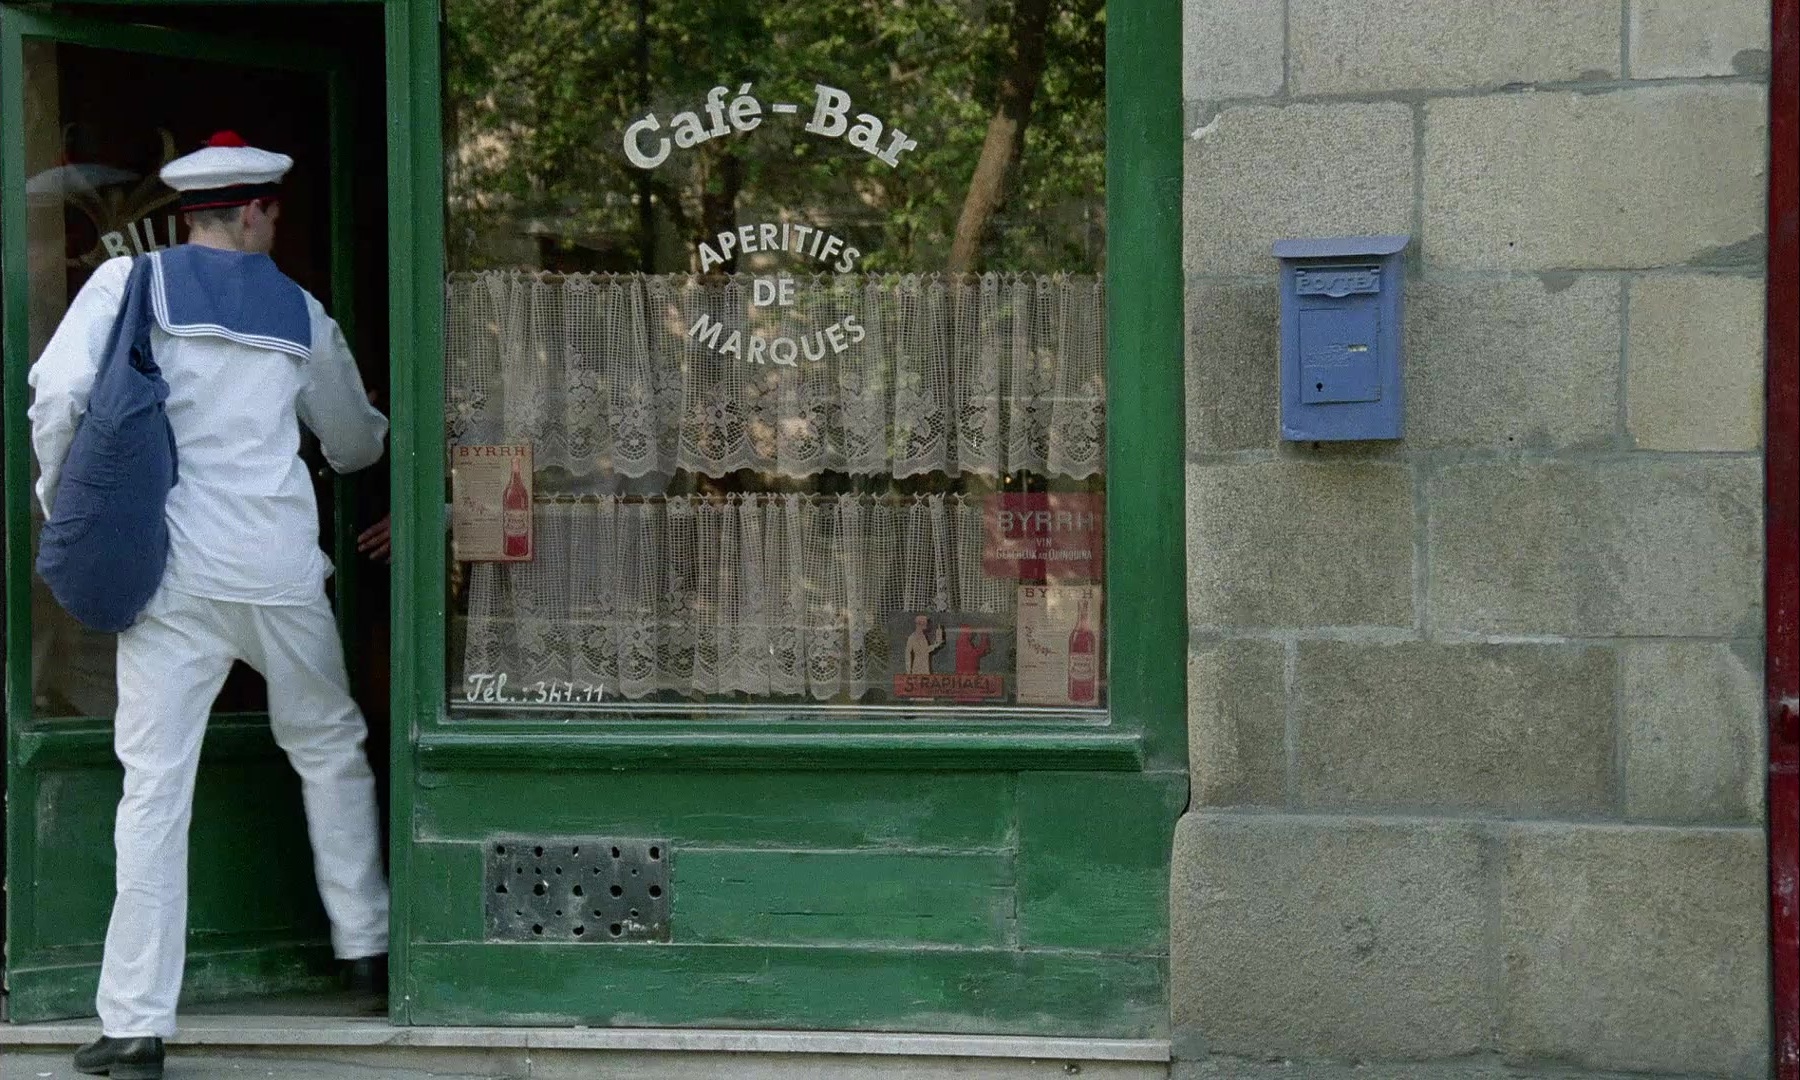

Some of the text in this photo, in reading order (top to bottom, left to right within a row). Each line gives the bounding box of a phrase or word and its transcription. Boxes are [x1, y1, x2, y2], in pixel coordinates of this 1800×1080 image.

[698, 223, 860, 274] APERITIFS
[753, 279, 795, 307] DE
[688, 313, 866, 367] MARQUES
[460, 446, 526, 457] BYRRH
[997, 510, 1095, 532] BYRRH
